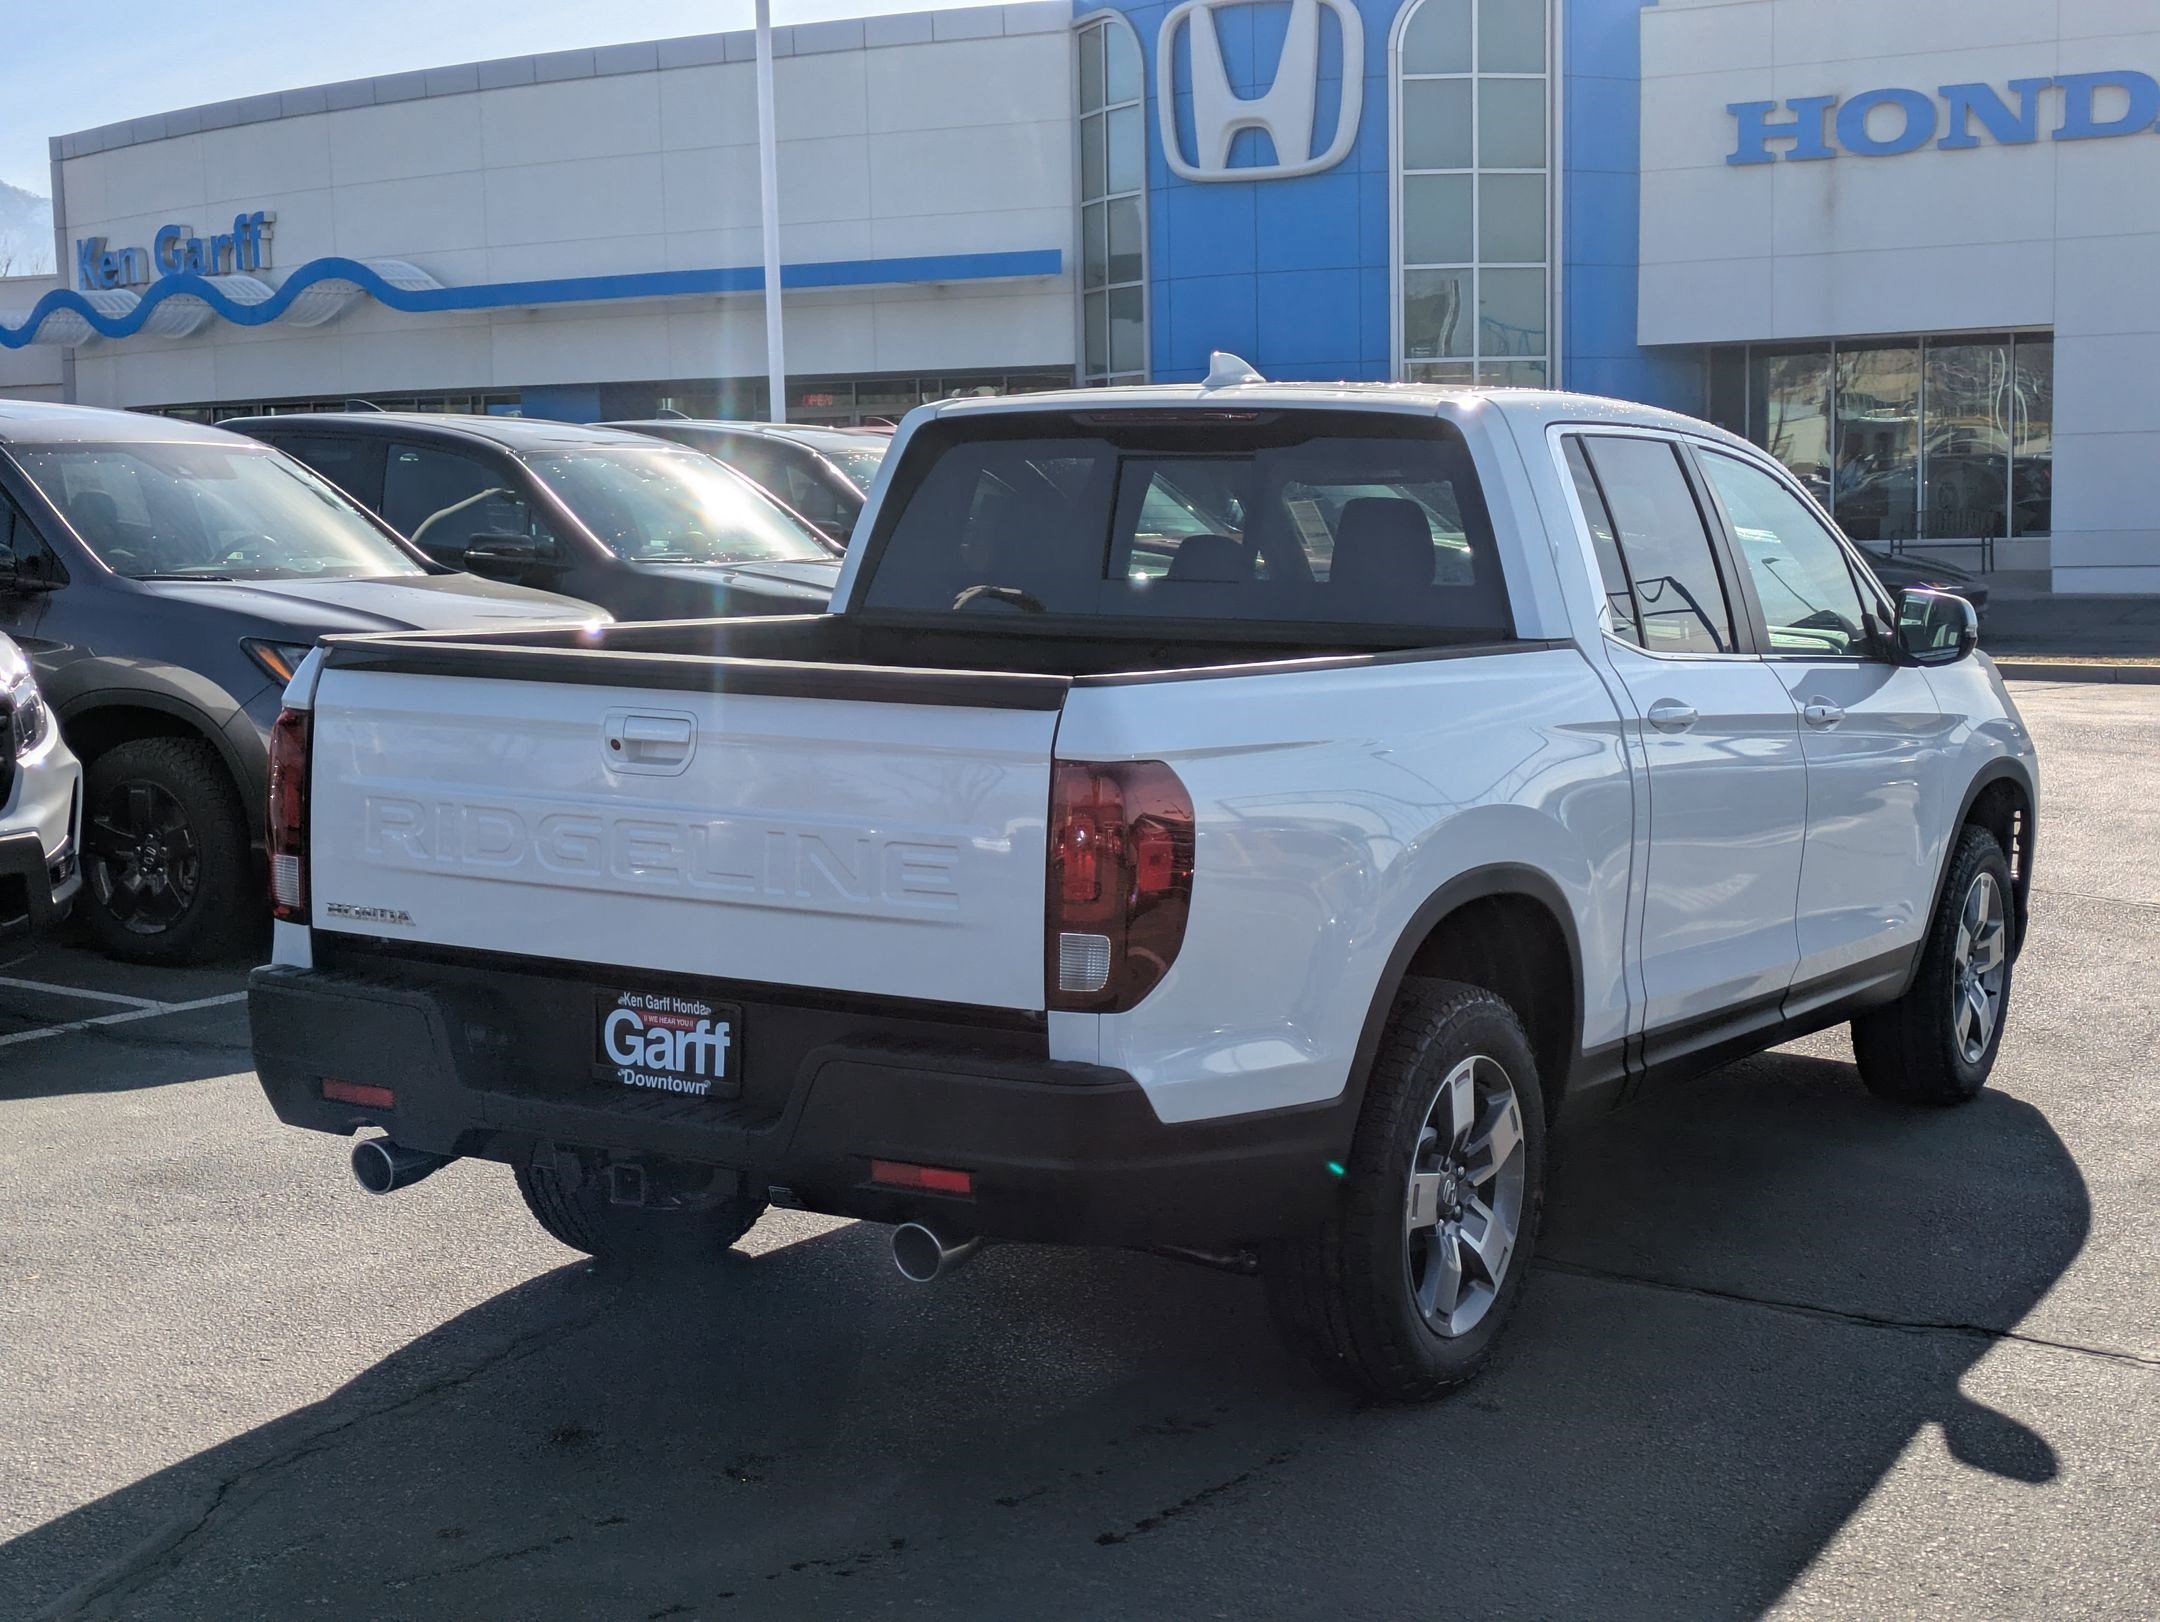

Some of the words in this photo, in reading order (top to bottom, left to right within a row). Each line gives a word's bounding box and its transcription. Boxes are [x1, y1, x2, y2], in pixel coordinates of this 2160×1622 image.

[1726, 70, 2160, 166] HOND
[77, 236, 147, 290] Ken
[154, 211, 274, 277] Garff
[364, 795, 960, 911] RIDGELINE
[326, 902, 416, 927] HONDA
[624, 992, 642, 1007] Ken
[646, 995, 670, 1011] Garff
[673, 998, 706, 1015] Honda
[648, 1015, 659, 1024] WE
[659, 1016, 676, 1025] HEAR
[676, 1018, 689, 1027] YOU
[604, 1009, 730, 1077] Garff
[624, 1069, 705, 1095] Downtown
